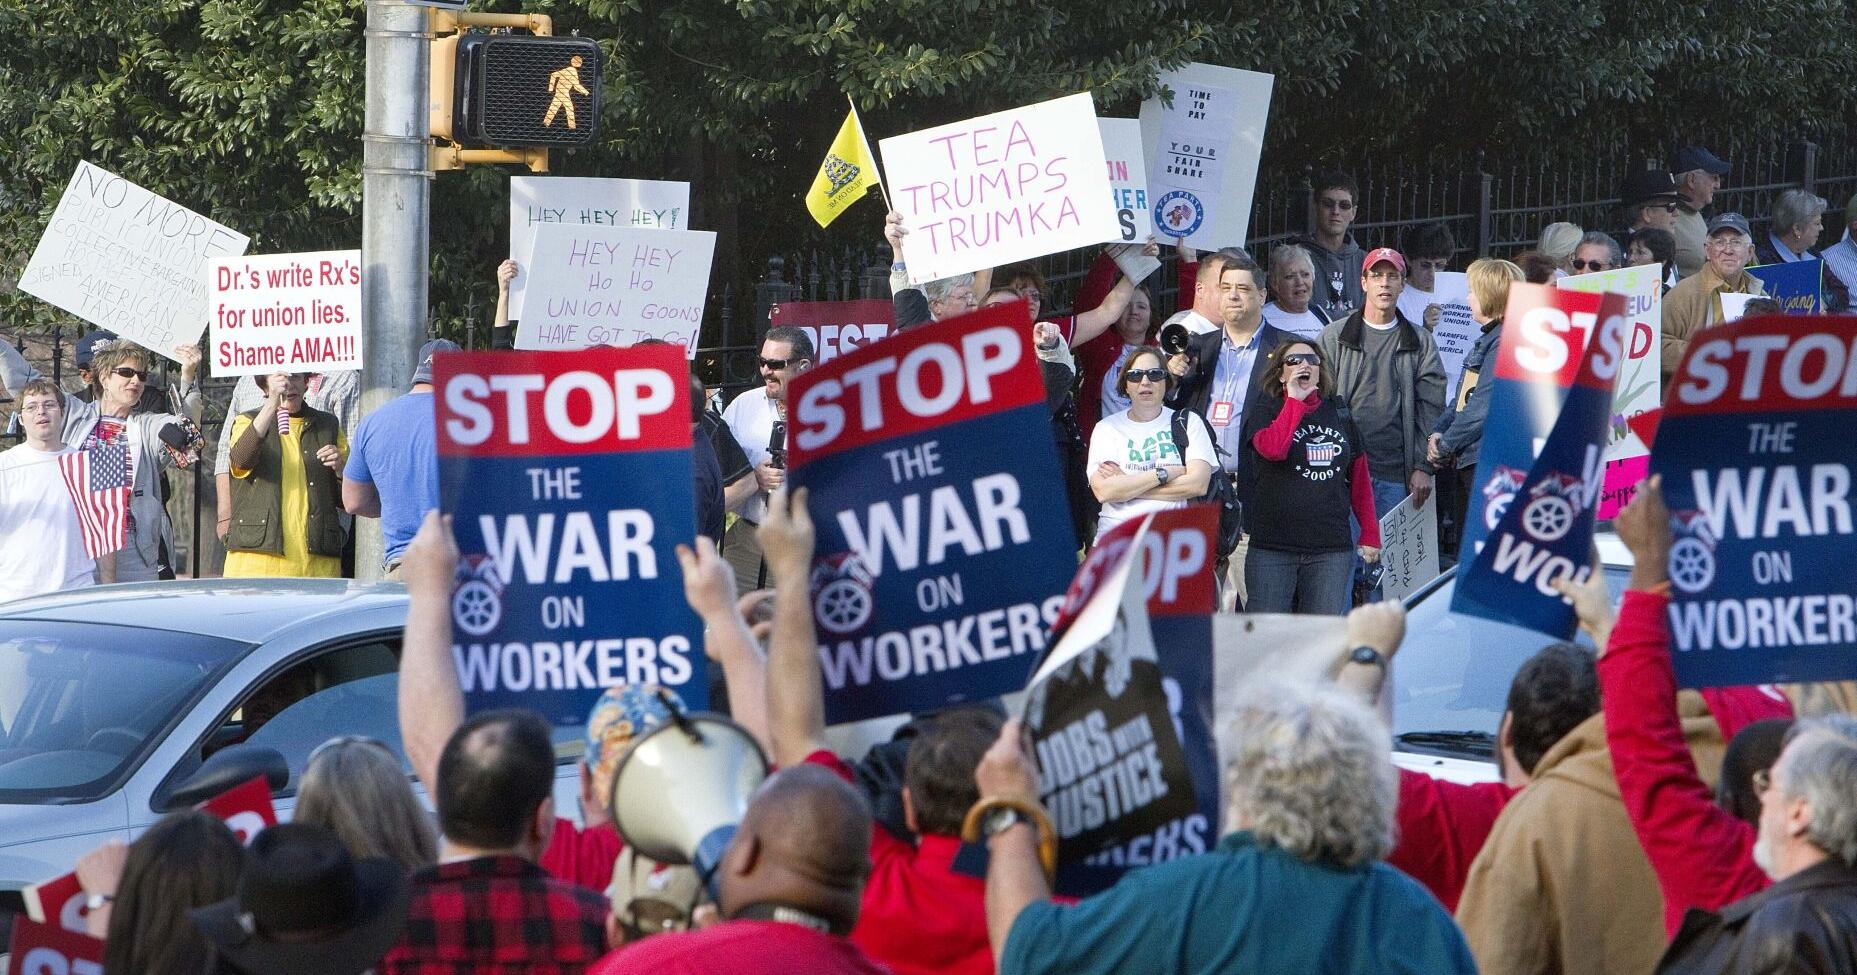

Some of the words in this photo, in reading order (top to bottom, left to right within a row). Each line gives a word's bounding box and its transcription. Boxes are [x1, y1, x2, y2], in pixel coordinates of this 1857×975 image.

[1189, 89, 1211, 101] TIME
[1194, 100, 1205, 110] TO
[1188, 110, 1206, 120] PAY
[928, 119, 1036, 171] TEA
[1170, 142, 1216, 157] YOUR
[1174, 156, 1201, 167] FAIR
[901, 157, 1067, 216] TRUMPS
[1166, 165, 1204, 179] SHARE
[74, 165, 128, 208] NO
[134, 194, 238, 259] MORE
[528, 205, 565, 227] HEY
[580, 207, 618, 226] HEY
[919, 195, 1080, 255] TRUMKA
[63, 194, 139, 245] PUBLIC
[145, 231, 207, 274] UNION
[54, 218, 152, 273] COLLECTIVE
[151, 262, 208, 299] BARGAININ
[569, 239, 620, 268] HEY
[632, 244, 682, 275] HEY
[218, 264, 260, 291] Dr.'s
[267, 262, 313, 288] write
[320, 259, 360, 286] Rx's
[80, 273, 177, 329] AMERICAN
[218, 303, 246, 329] for
[252, 300, 305, 328] union
[312, 299, 350, 324] lies.
[547, 297, 622, 318] UNION
[641, 303, 701, 322] GOONS
[1440, 303, 1473, 312] GOVERNM
[1442, 310, 1474, 320] WORKER
[81, 292, 174, 348] TAXPAYER
[538, 324, 578, 344] HAVE
[587, 326, 625, 344] GOT
[1437, 331, 1469, 341] HARMFUL
[1444, 318, 1471, 327] UNIONS
[219, 341, 285, 367] Shame
[290, 335, 355, 363] AMA!!!
[1437, 346, 1464, 354] MERICA
[1679, 333, 1857, 406] STO
[796, 326, 1022, 451] STOP
[444, 367, 675, 446] STOP
[1747, 422, 1797, 454] THE
[884, 440, 944, 485] THE
[1302, 468, 1334, 481] 2009
[527, 466, 582, 500] THE
[1692, 462, 1854, 540] WAR
[837, 471, 1031, 579] WAR
[479, 508, 658, 587] WAR
[1752, 550, 1793, 585] ON
[917, 572, 965, 613] ON
[541, 595, 585, 629] ON
[1668, 593, 1857, 653] WORKER
[452, 634, 693, 693] WORKERS
[1035, 708, 1108, 793] JOBS
[1046, 744, 1169, 839] JUSTICE
